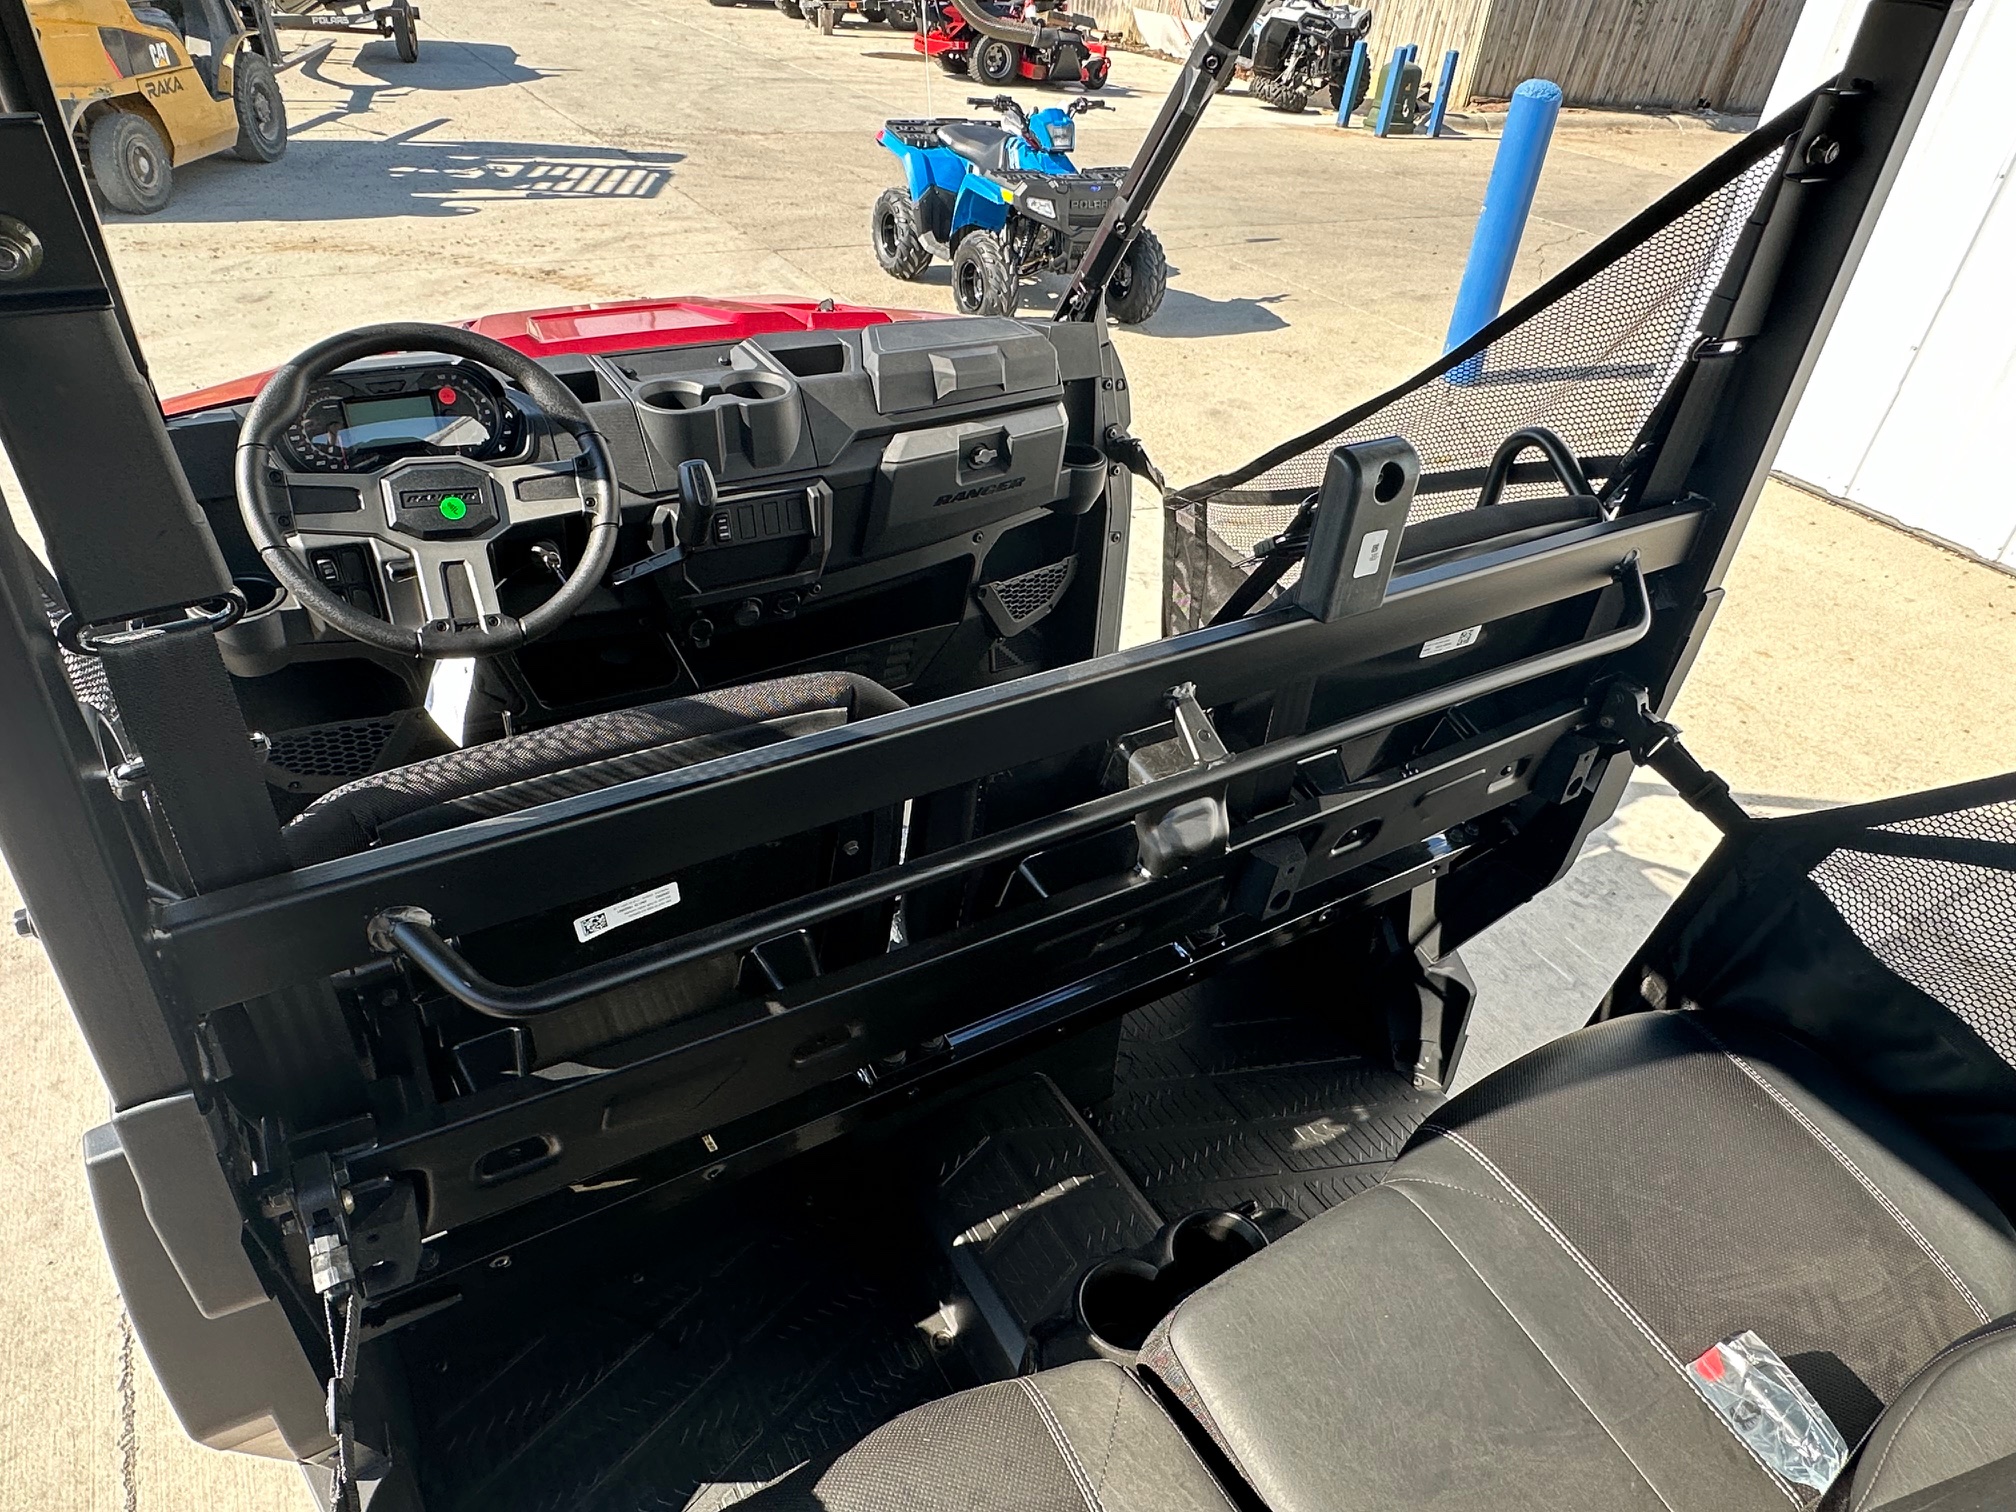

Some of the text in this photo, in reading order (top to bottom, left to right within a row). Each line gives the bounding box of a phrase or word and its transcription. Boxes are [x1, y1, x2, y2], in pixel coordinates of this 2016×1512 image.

[149, 41, 171, 68] CAT
[145, 76, 184, 99] RAKA
[1070, 199, 1111, 209] POLARI
[933, 476, 1026, 507] RANGER
